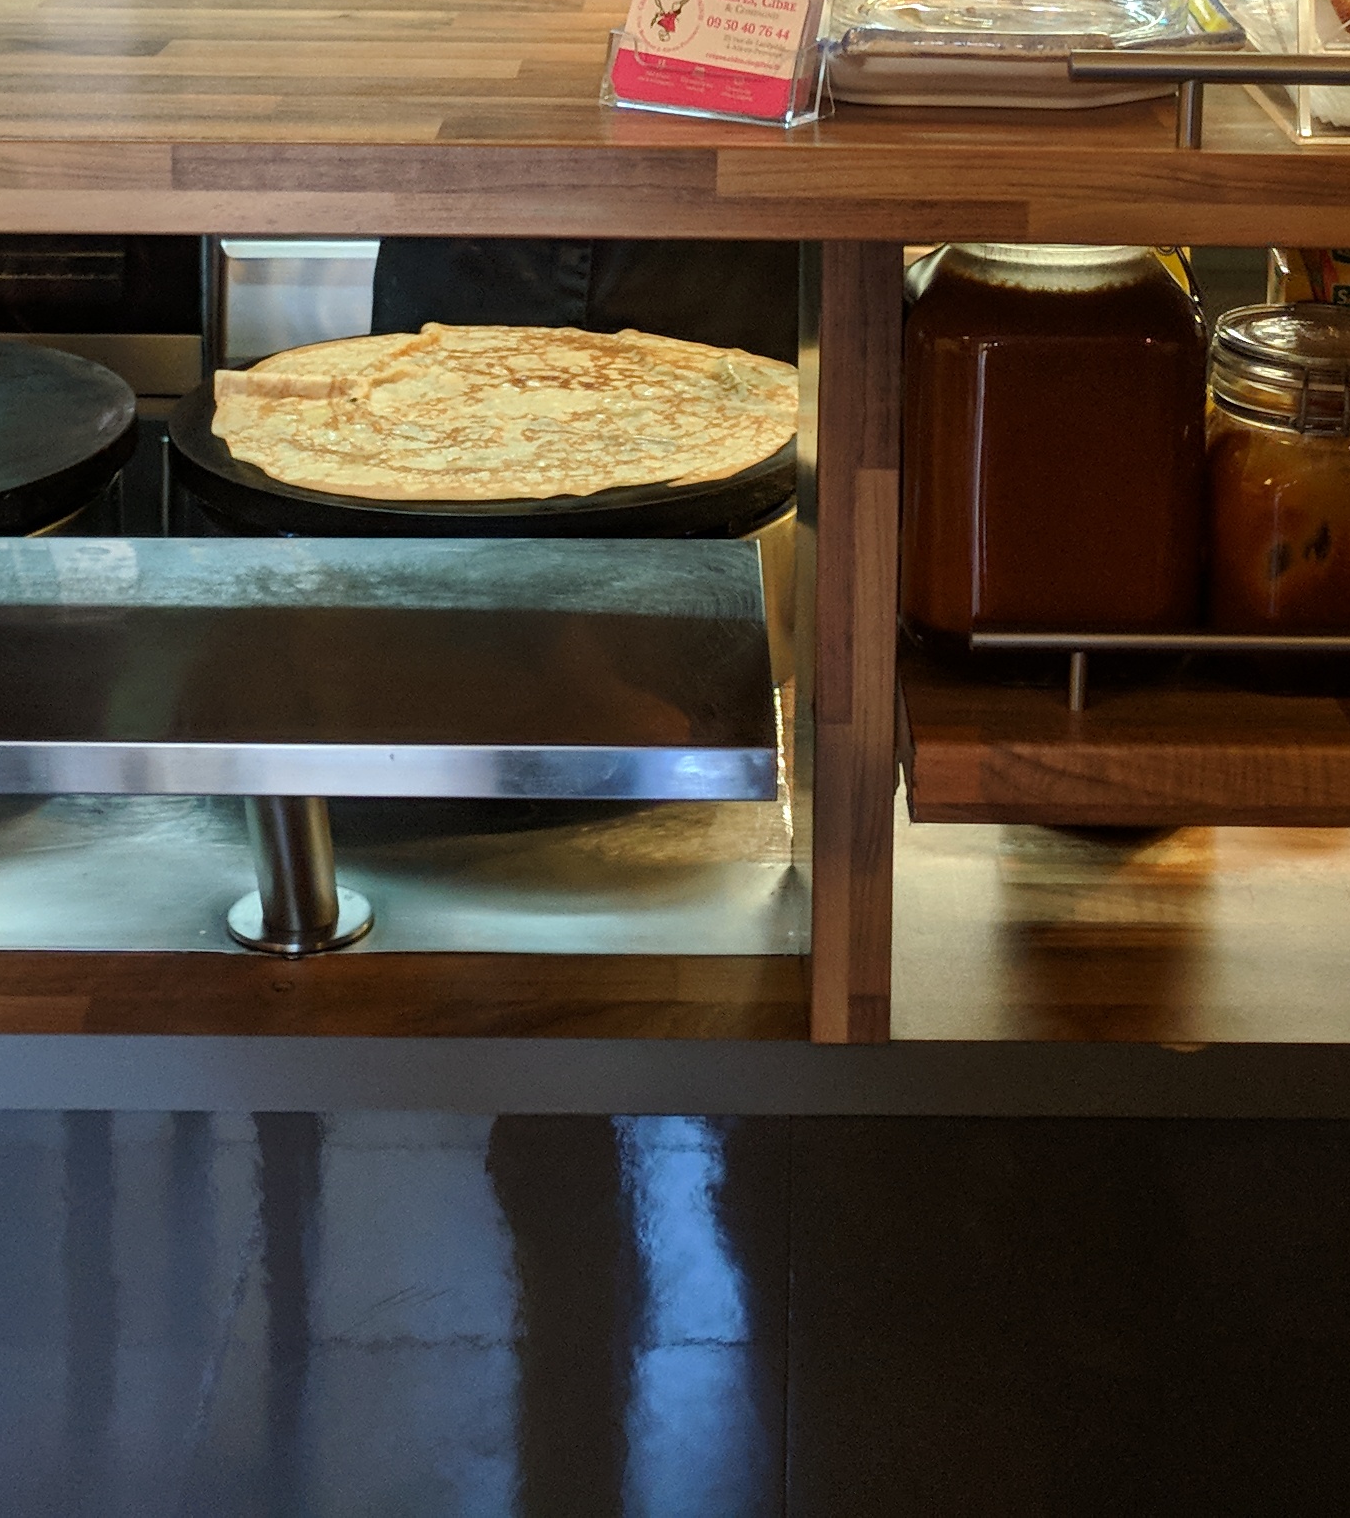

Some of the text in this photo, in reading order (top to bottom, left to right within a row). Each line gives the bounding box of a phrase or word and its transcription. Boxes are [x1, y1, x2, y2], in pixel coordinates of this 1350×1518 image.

[706, 15, 721, 30] 09
[741, 20, 756, 35] 40
[759, 23, 773, 38] 76
[776, 27, 790, 42] 44
